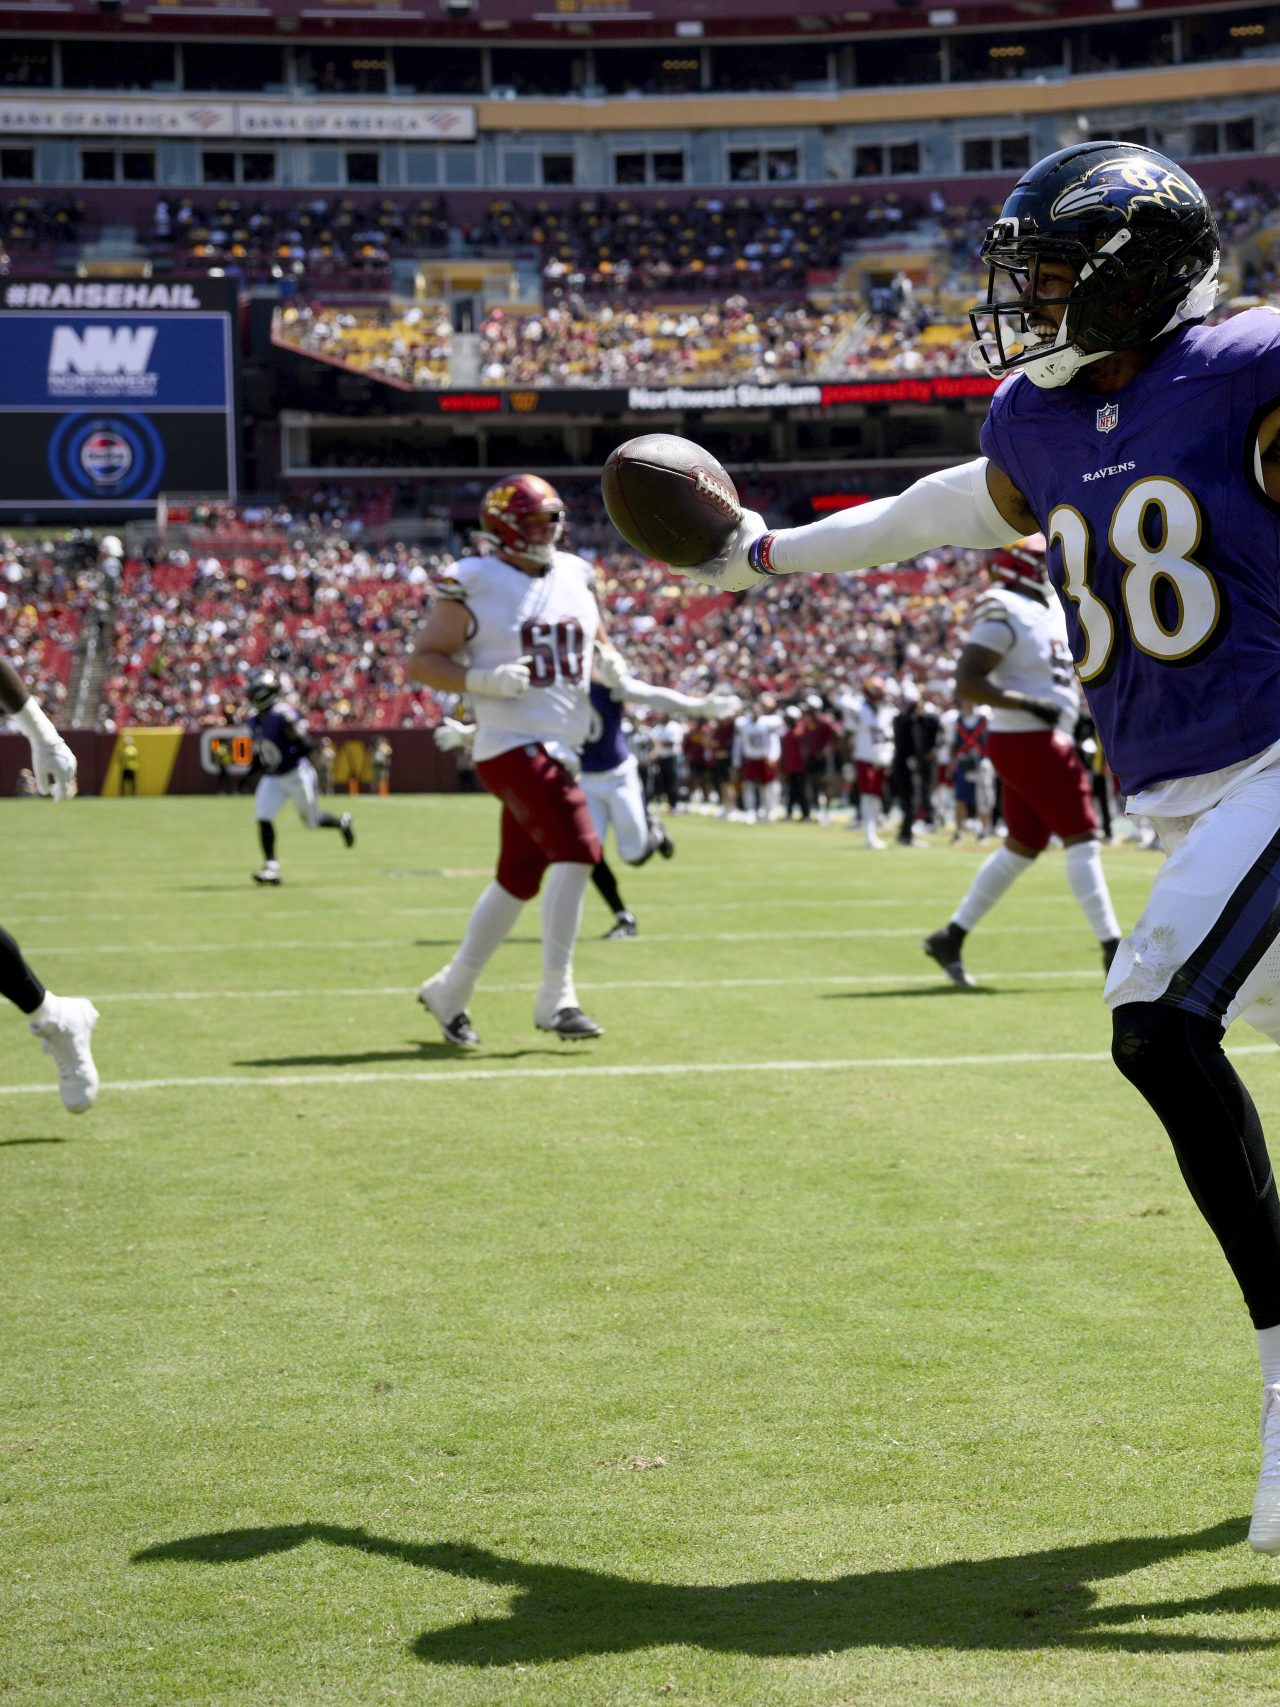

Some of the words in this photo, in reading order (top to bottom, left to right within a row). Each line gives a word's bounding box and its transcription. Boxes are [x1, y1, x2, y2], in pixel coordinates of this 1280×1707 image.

[6, 283, 201, 309] #RAISEHAIL
[48, 325, 158, 374] NW
[736, 384, 821, 406] Stadium
[932, 376, 1004, 398] Verizo
[1100, 415, 1115, 428] NFL
[1081, 461, 1136, 482] RAVENS
[1048, 476, 1220, 682] 38
[521, 616, 584, 687] 60
